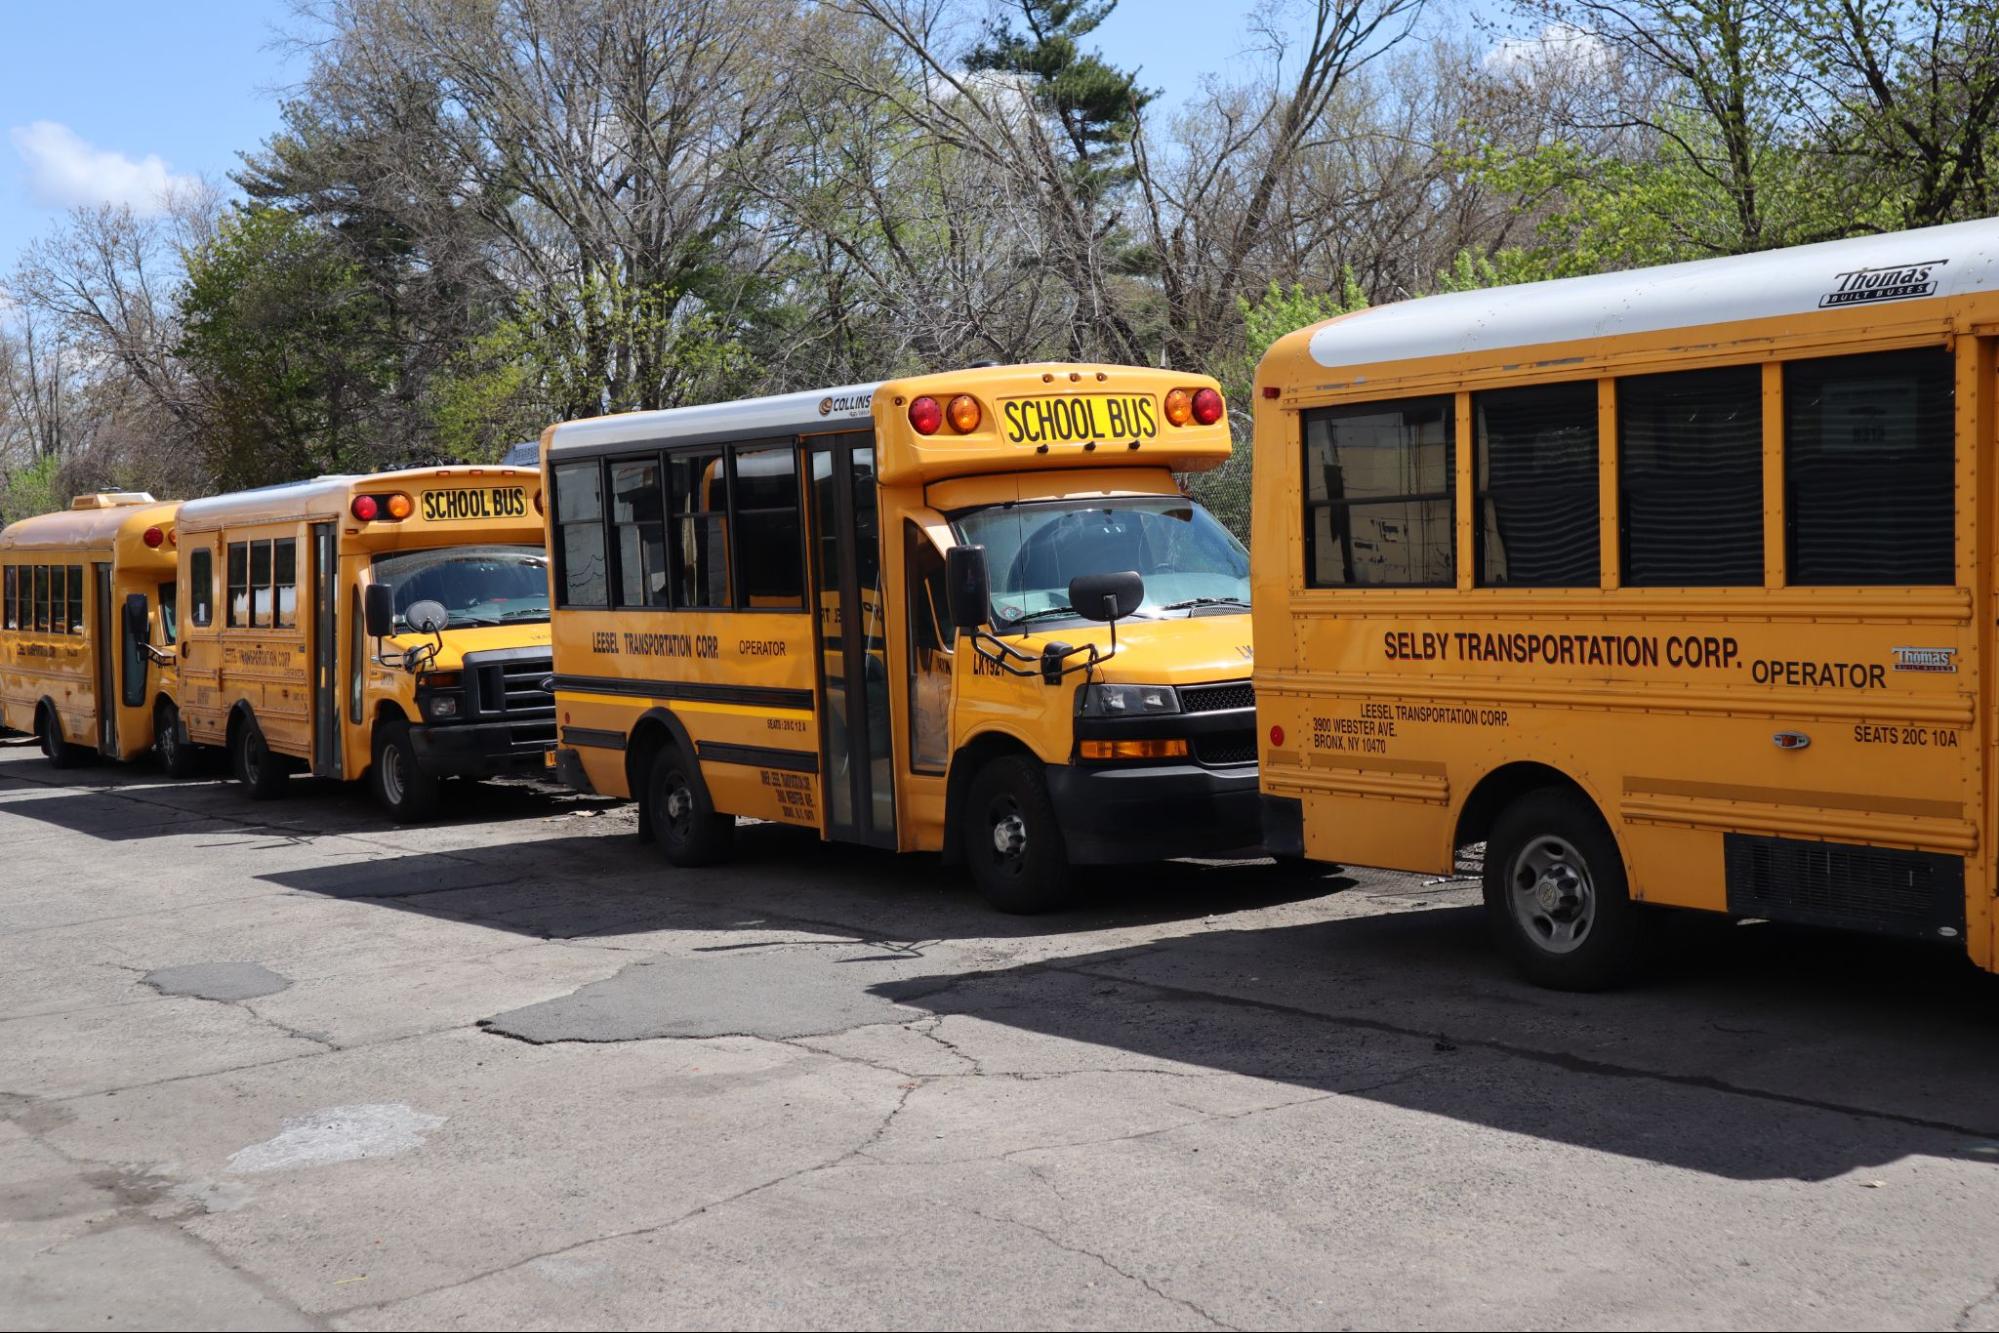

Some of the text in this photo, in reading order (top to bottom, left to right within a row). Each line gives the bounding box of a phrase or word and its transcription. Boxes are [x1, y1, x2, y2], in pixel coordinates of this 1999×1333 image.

[1835, 261, 1942, 292] Thomas
[1830, 285, 1925, 303] BUILT BUSES
[833, 394, 872, 412] COLLINS
[1004, 397, 1157, 443] SCHOOL BUS
[424, 488, 524, 519] SCHOOL BUS
[592, 632, 620, 654] LEESEL
[624, 633, 693, 658] TRANSPORTATION
[739, 639, 787, 657] OPERATOR
[1384, 631, 1743, 669] SELBY TRANSPORTATION CORP.
[1892, 648, 1956, 665] Thomas
[1752, 659, 1887, 689] OPERATOR
[1360, 703, 1510, 727] LEESEL TRANSPORTATION CORP.
[1313, 717, 1398, 738] 3900 WEBSTER AVE.
[1853, 725, 1958, 747] SEATS 20C 10A
[1314, 733, 1386, 754] BRONX, NY 10470
